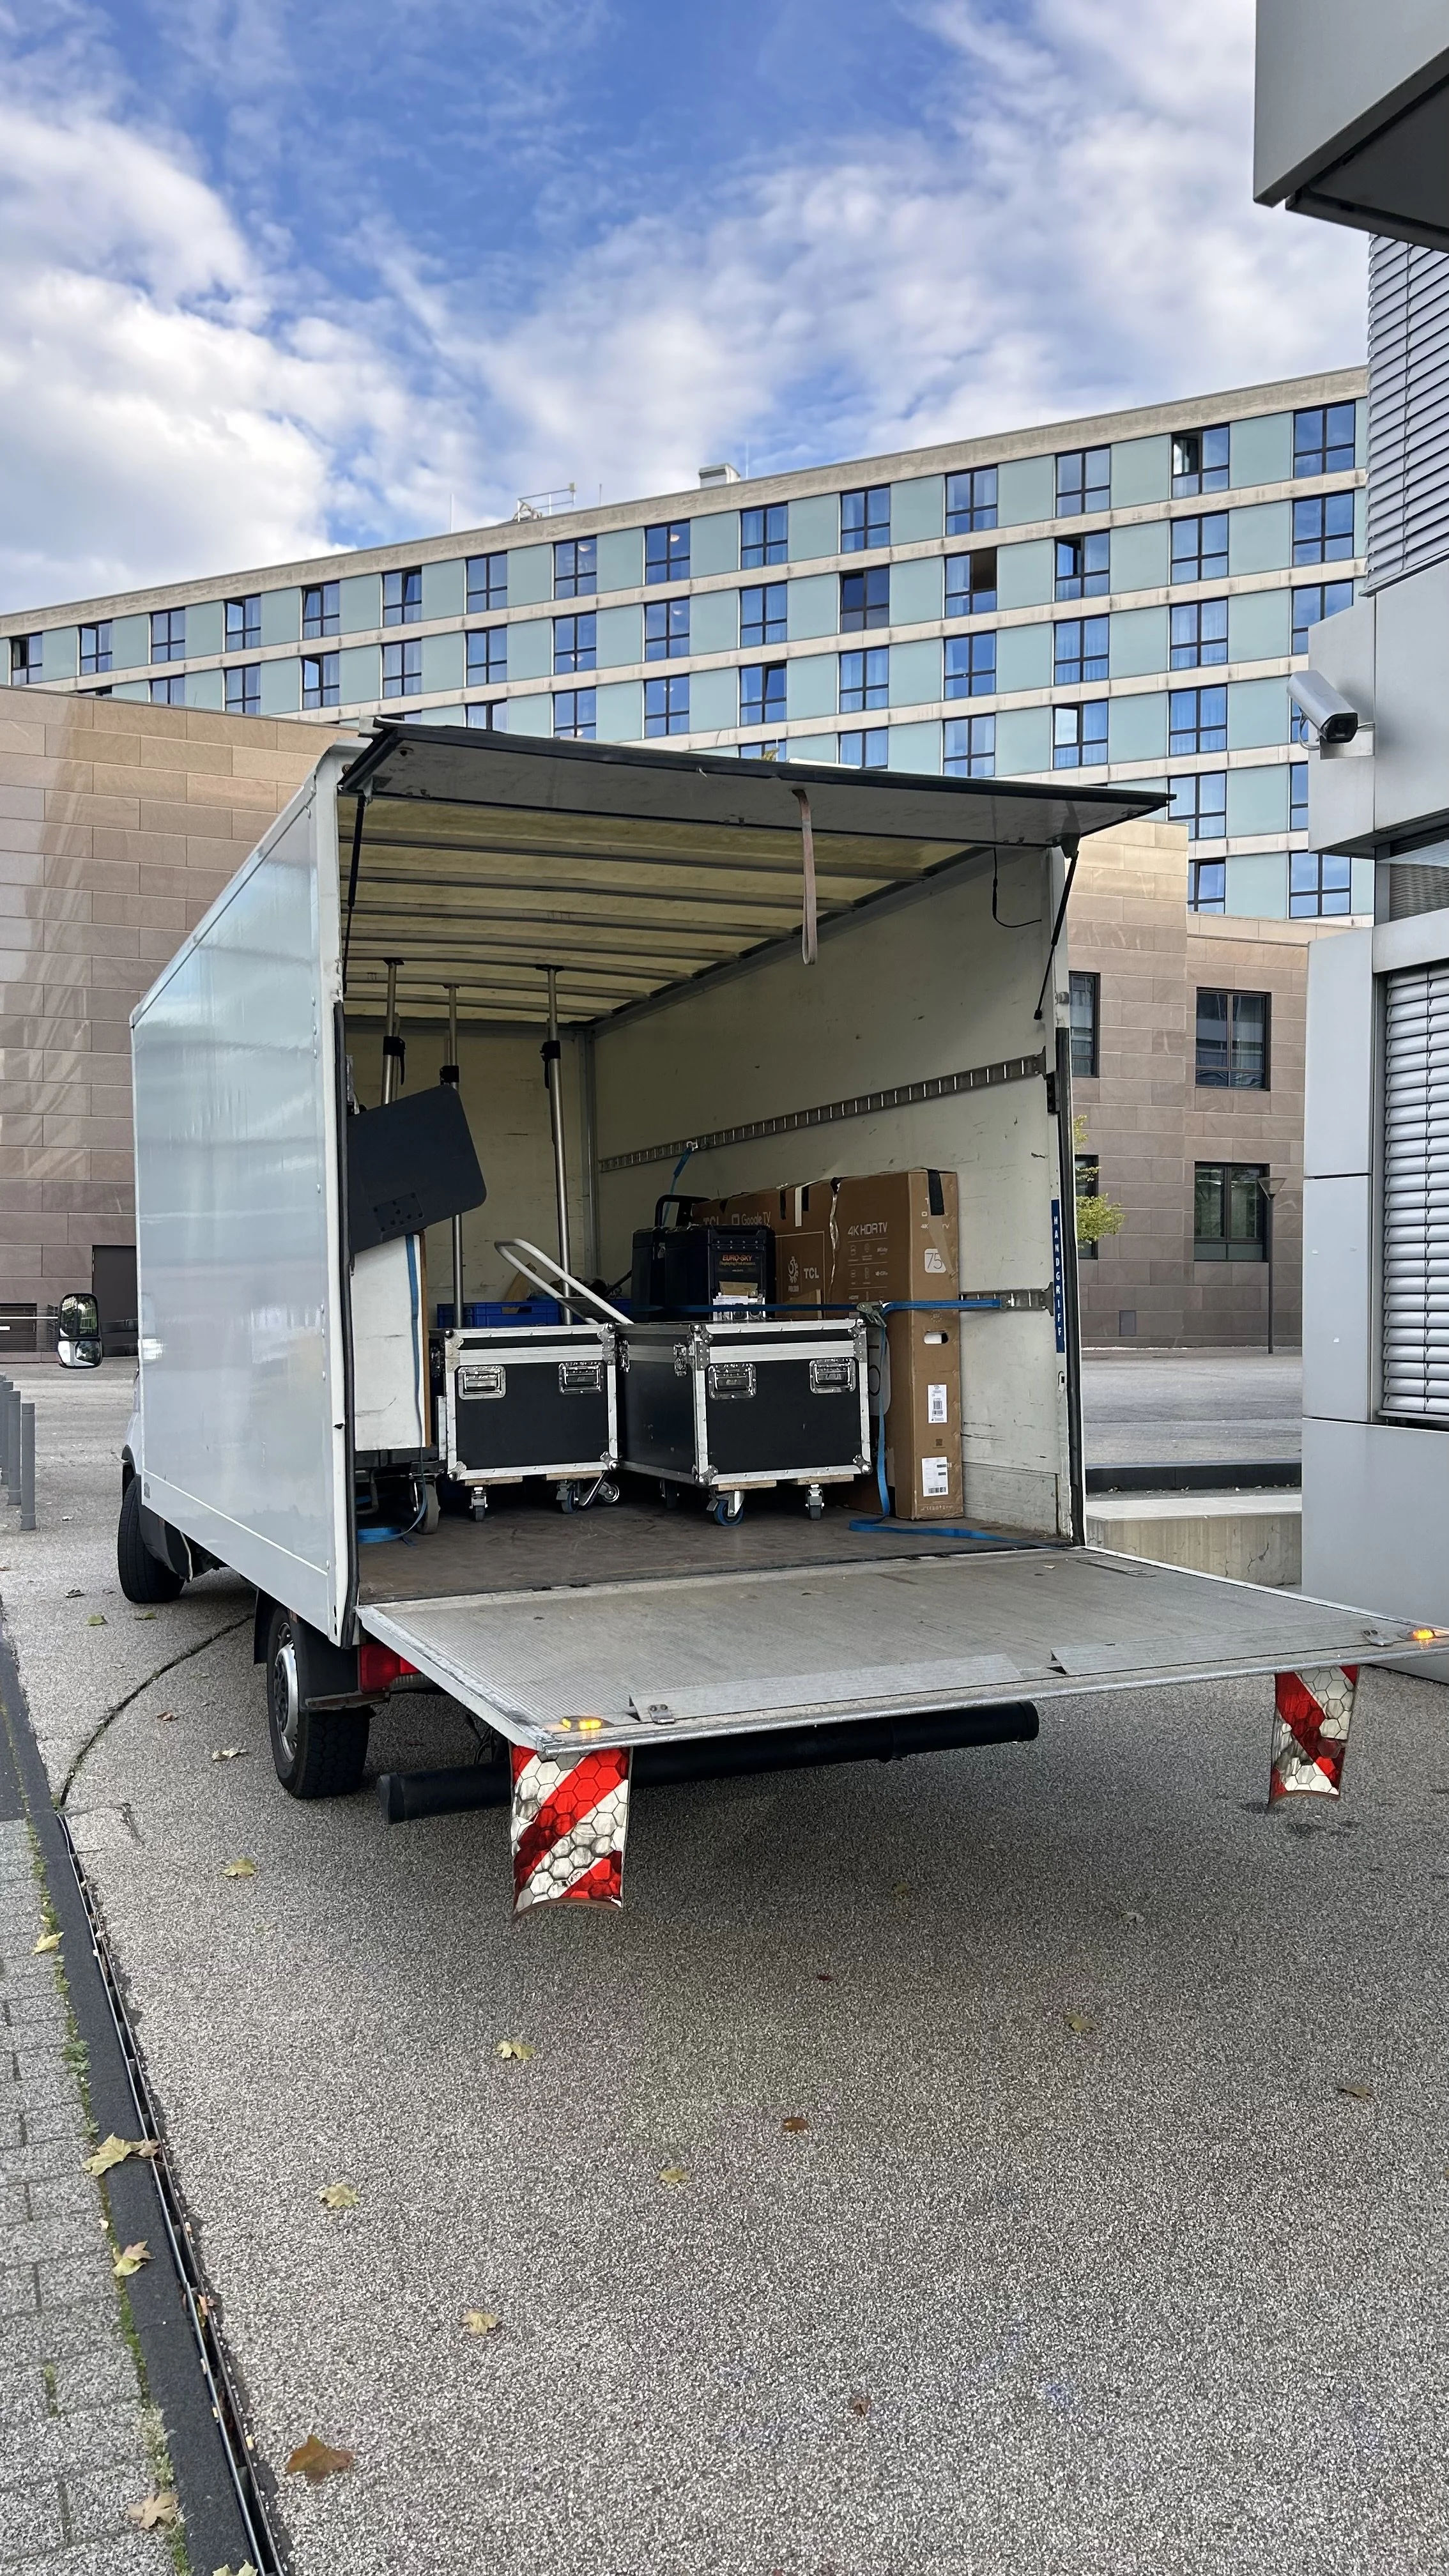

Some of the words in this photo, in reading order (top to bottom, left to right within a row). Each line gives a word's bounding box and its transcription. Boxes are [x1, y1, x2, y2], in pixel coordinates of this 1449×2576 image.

[741, 1212, 762, 1225] Google
[762, 1211, 771, 1225] TV
[847, 1225, 859, 1236] 4K
[925, 1252, 943, 1269] 75
[803, 1267, 820, 1279] TCL
[1054, 1216, 1062, 1336] HANDGRIFF
